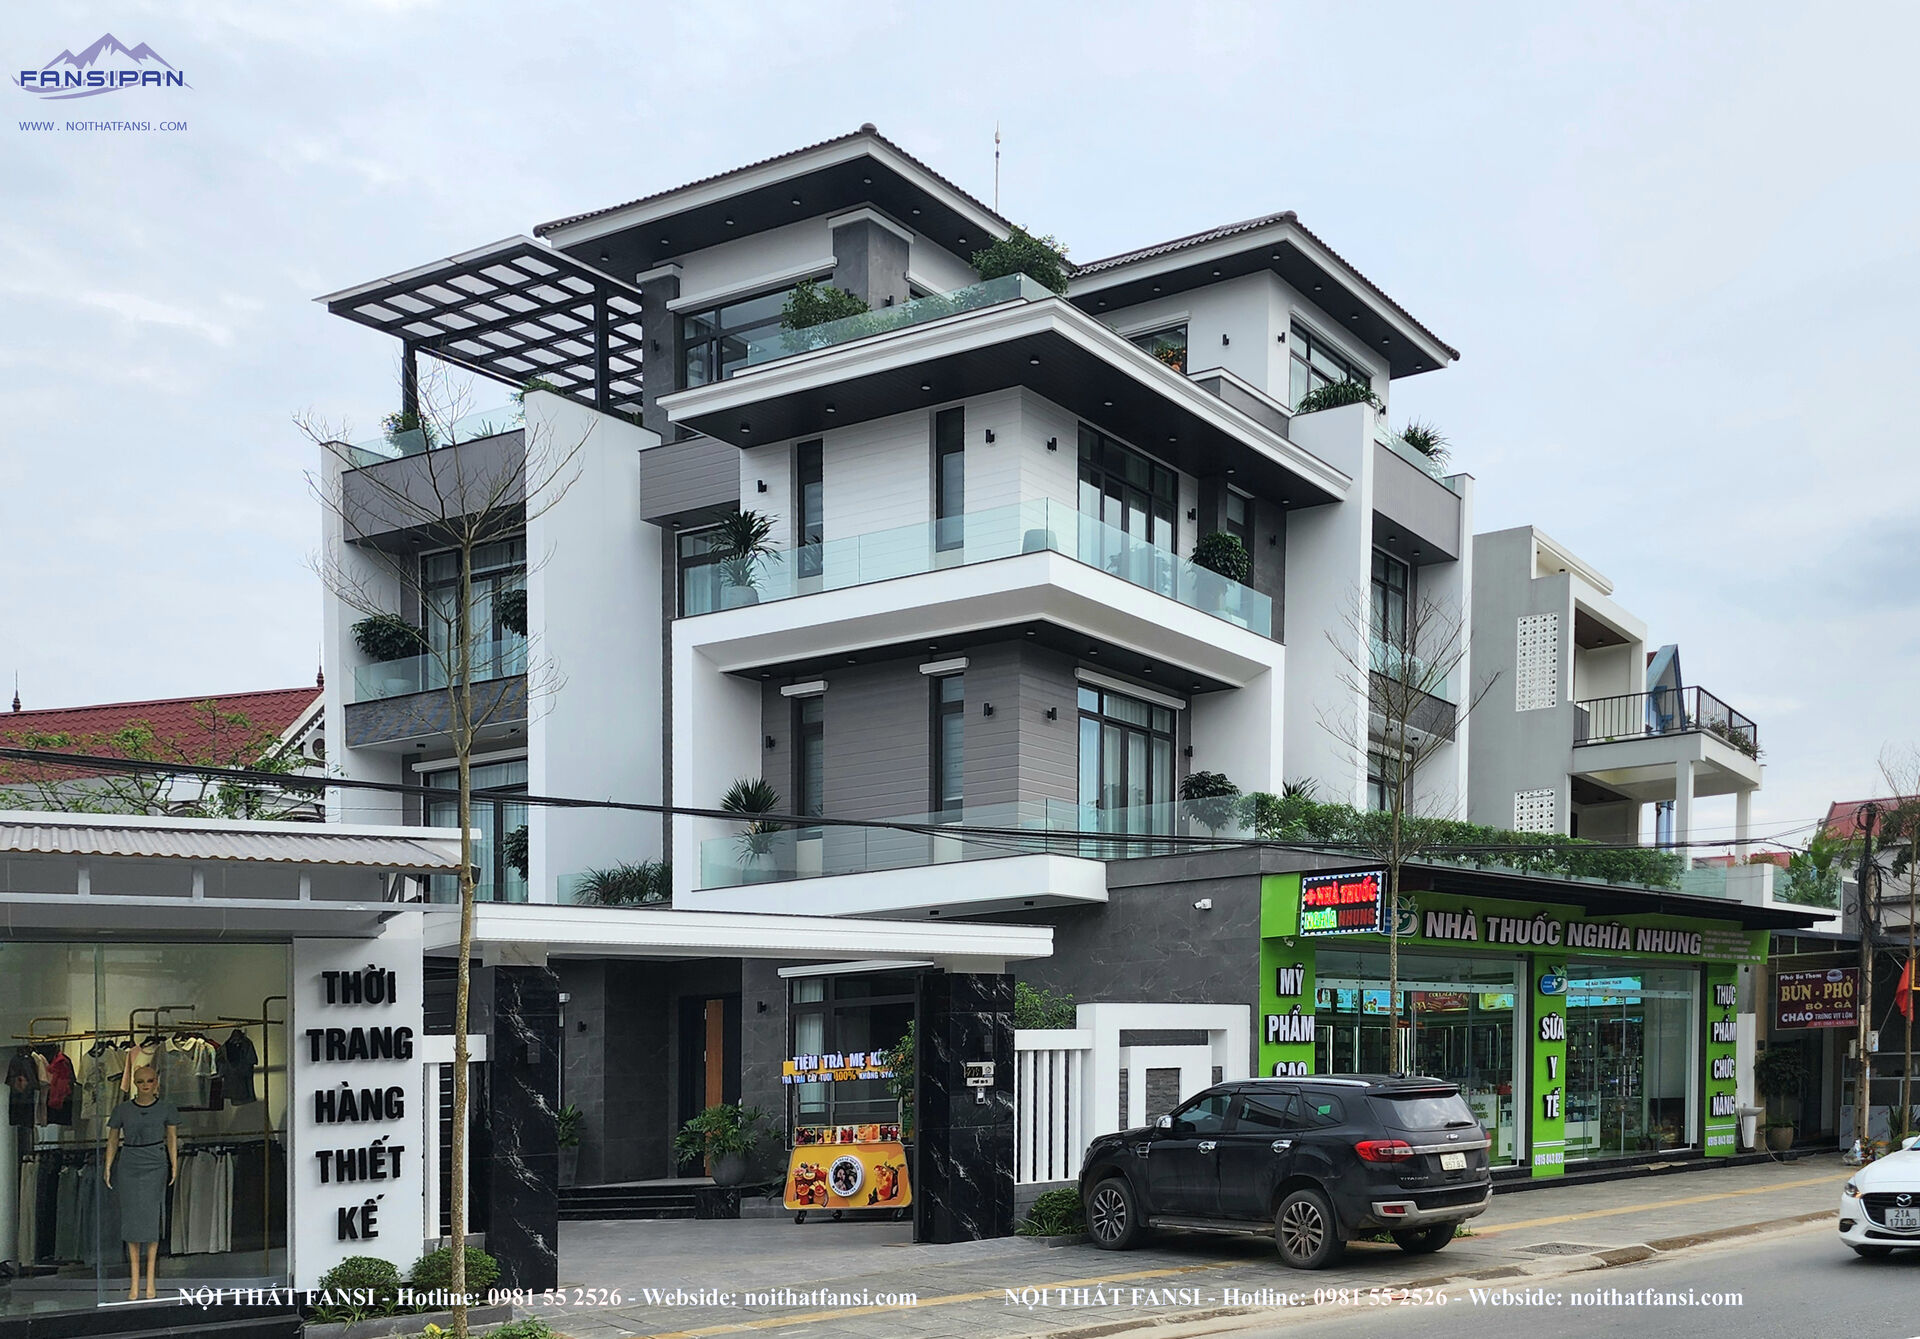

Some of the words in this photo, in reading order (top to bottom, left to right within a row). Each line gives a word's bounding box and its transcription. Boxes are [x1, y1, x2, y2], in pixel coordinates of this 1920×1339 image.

[1316, 881, 1339, 905] NHÀ
[1340, 875, 1377, 904] THUỐC
[1338, 908, 1375, 926] NHUNG
[1425, 909, 1478, 941] NHÀ
[1486, 912, 1561, 945] THUỐC
[1567, 922, 1631, 950] NGHĨA
[1637, 928, 1702, 955] NHUNG
[322, 963, 397, 1004] THỜI
[1279, 963, 1305, 995] MỸ
[1781, 980, 1812, 1001] BÚN
[1716, 984, 1736, 1008] THỰC
[1268, 1004, 1315, 1042] PHẨM
[1542, 1013, 1565, 1040] SỮA
[1713, 1015, 1736, 1042] PHẨM
[306, 1026, 414, 1062] TRANG
[793, 1054, 818, 1073] TIỆM
[823, 1051, 844, 1069] TRÀ
[850, 1052, 865, 1070] MẸ
[834, 1069, 856, 1081] 100%
[1550, 1056, 1558, 1079] Y
[1714, 1056, 1735, 1079] CHỨC
[315, 1081, 405, 1123] HÀNG
[1546, 1087, 1561, 1117] TẾ
[1713, 1093, 1735, 1115] NĂNG
[315, 1134, 405, 1183] THIẾT
[337, 1193, 385, 1240] KẾ
[1890, 1218, 1917, 1226] 171.00
[1894, 1209, 1910, 1217] 21A
